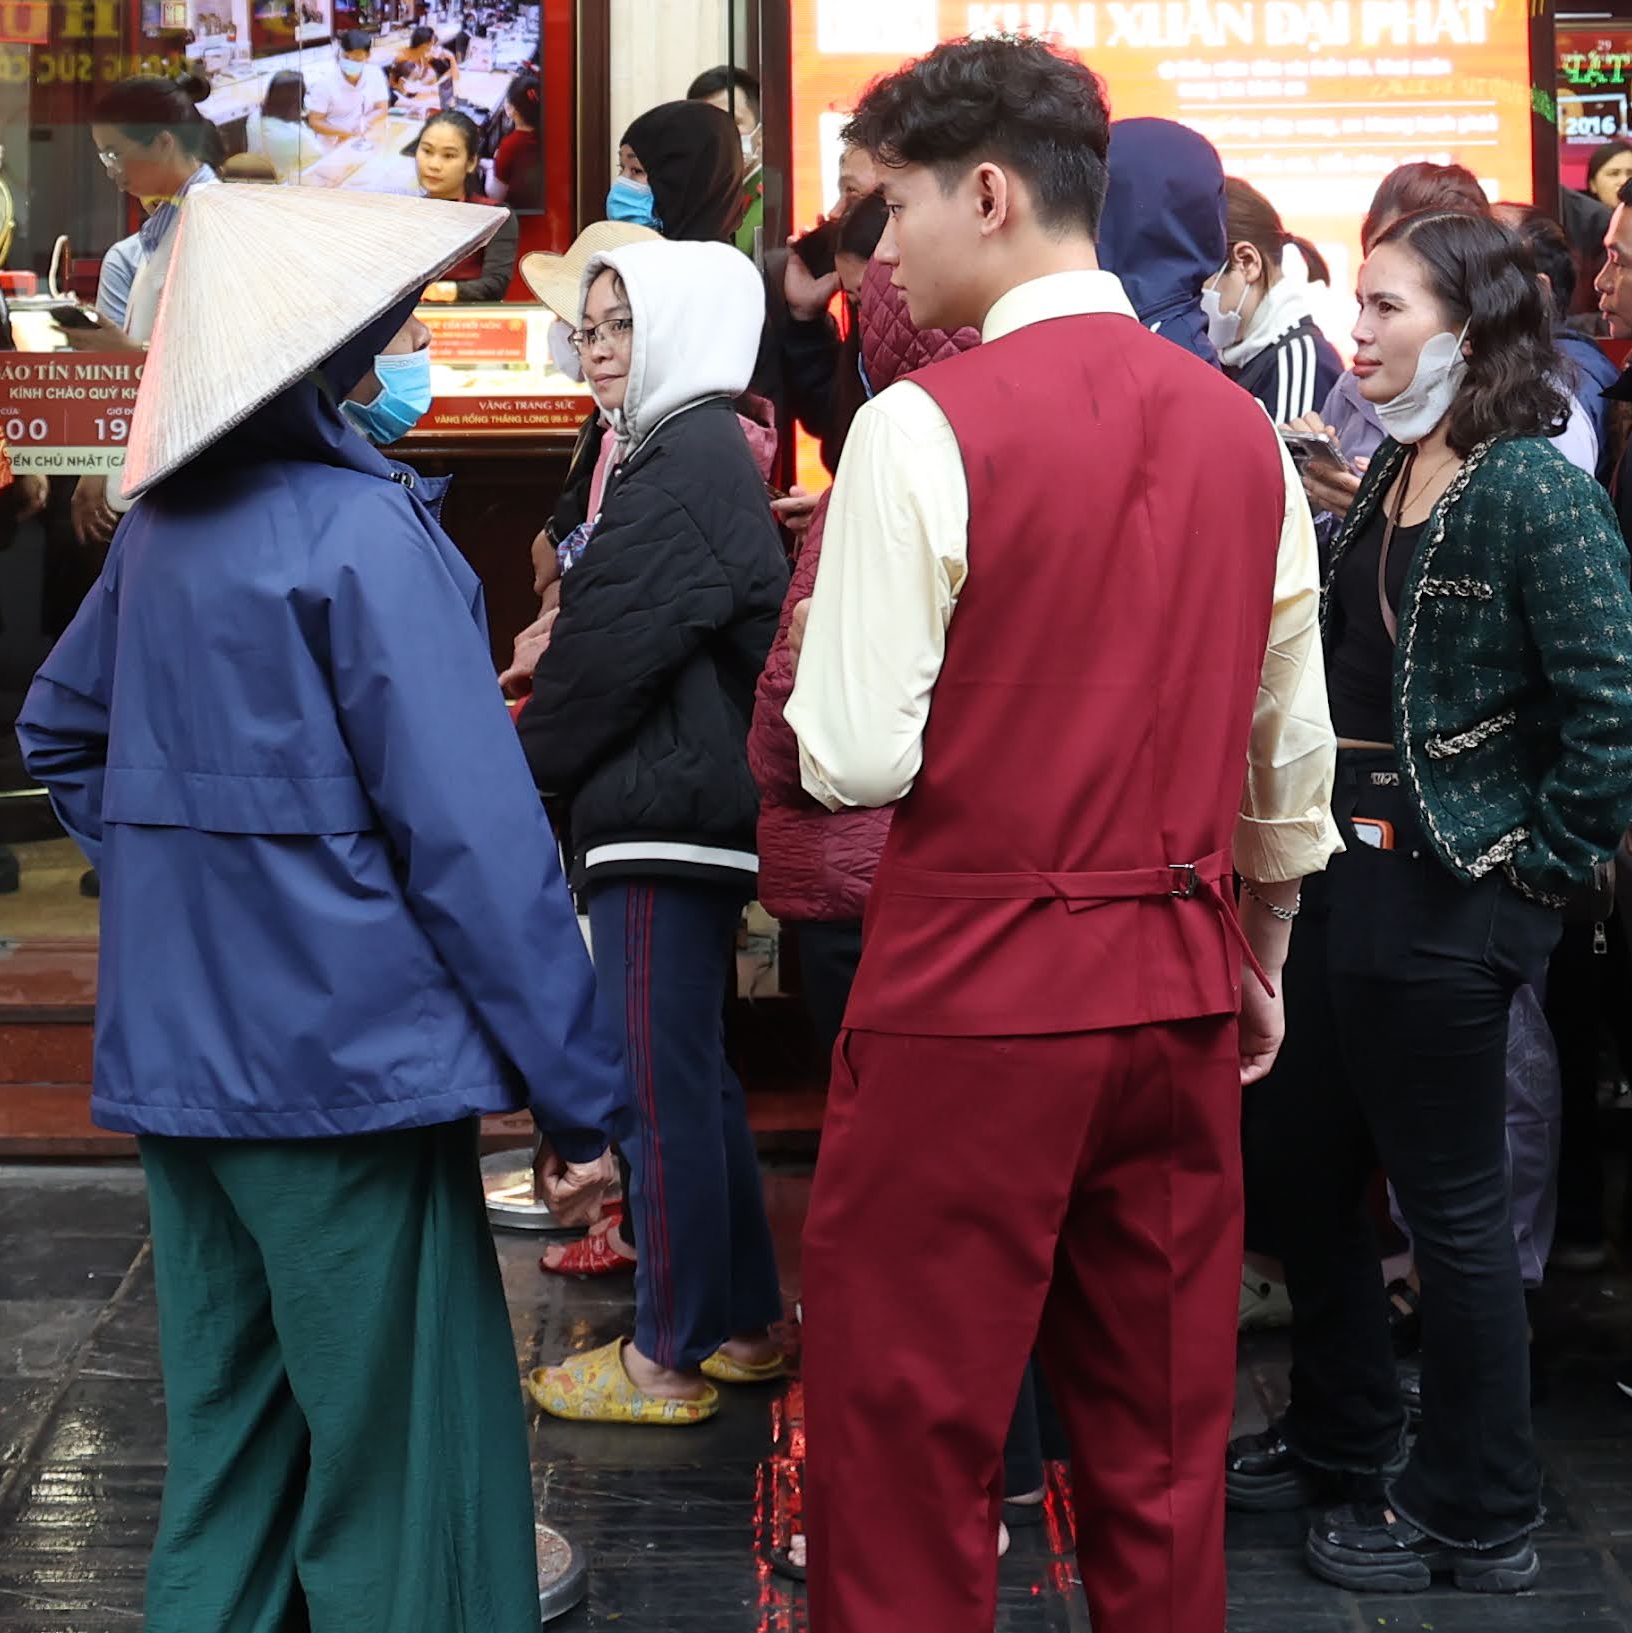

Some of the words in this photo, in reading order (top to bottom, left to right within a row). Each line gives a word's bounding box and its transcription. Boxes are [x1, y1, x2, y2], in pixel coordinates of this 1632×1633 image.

[1566, 115, 1616, 136] 2016
[34, 358, 69, 382] TÍN
[75, 364, 130, 382] MINH
[9, 384, 42, 400] KÍNH
[46, 385, 86, 400] CHÀO
[67, 452, 103, 470] NHẬT
